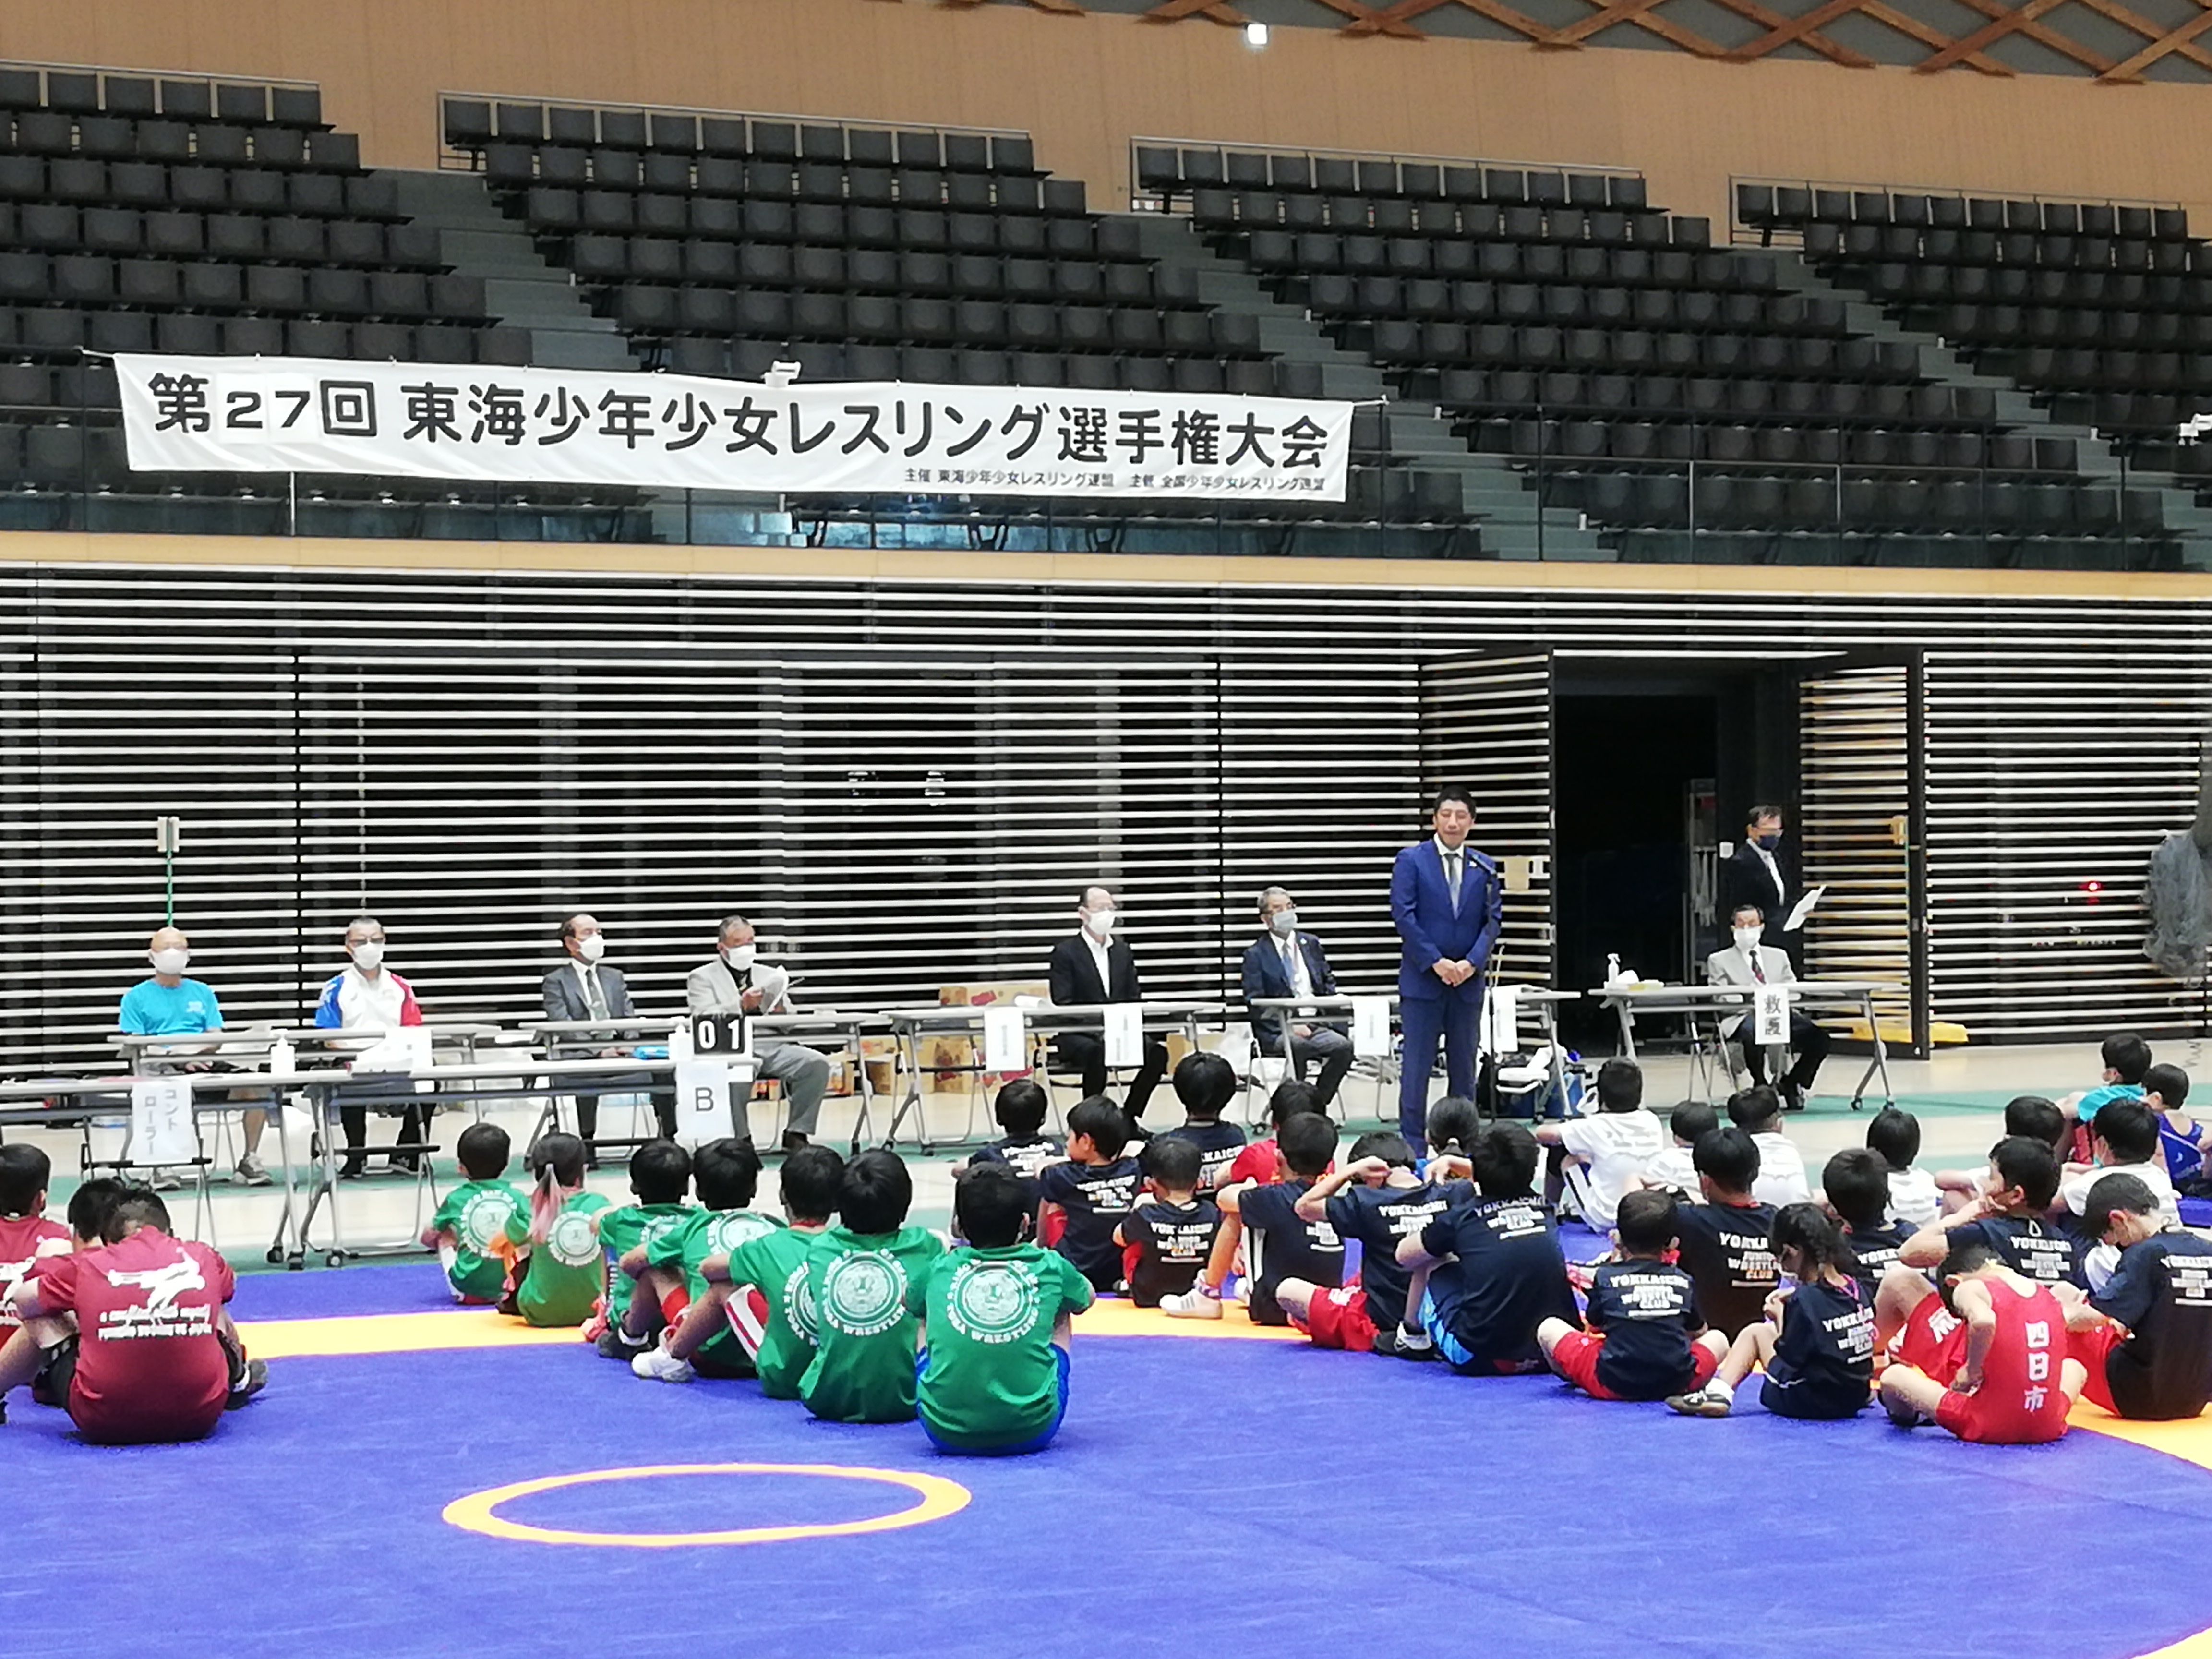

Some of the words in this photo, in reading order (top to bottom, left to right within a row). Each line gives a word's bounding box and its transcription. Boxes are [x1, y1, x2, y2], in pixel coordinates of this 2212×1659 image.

[147, 372, 378, 436] 第27回
[400, 381, 1328, 468] 東海少年少女レスリング選手権大会
[698, 1019, 739, 1050] 01
[165, 1089, 179, 1131] コント
[695, 1087, 714, 1111] B
[145, 1096, 156, 1155] ローラー
[2024, 1320, 2051, 1413] 四日市
